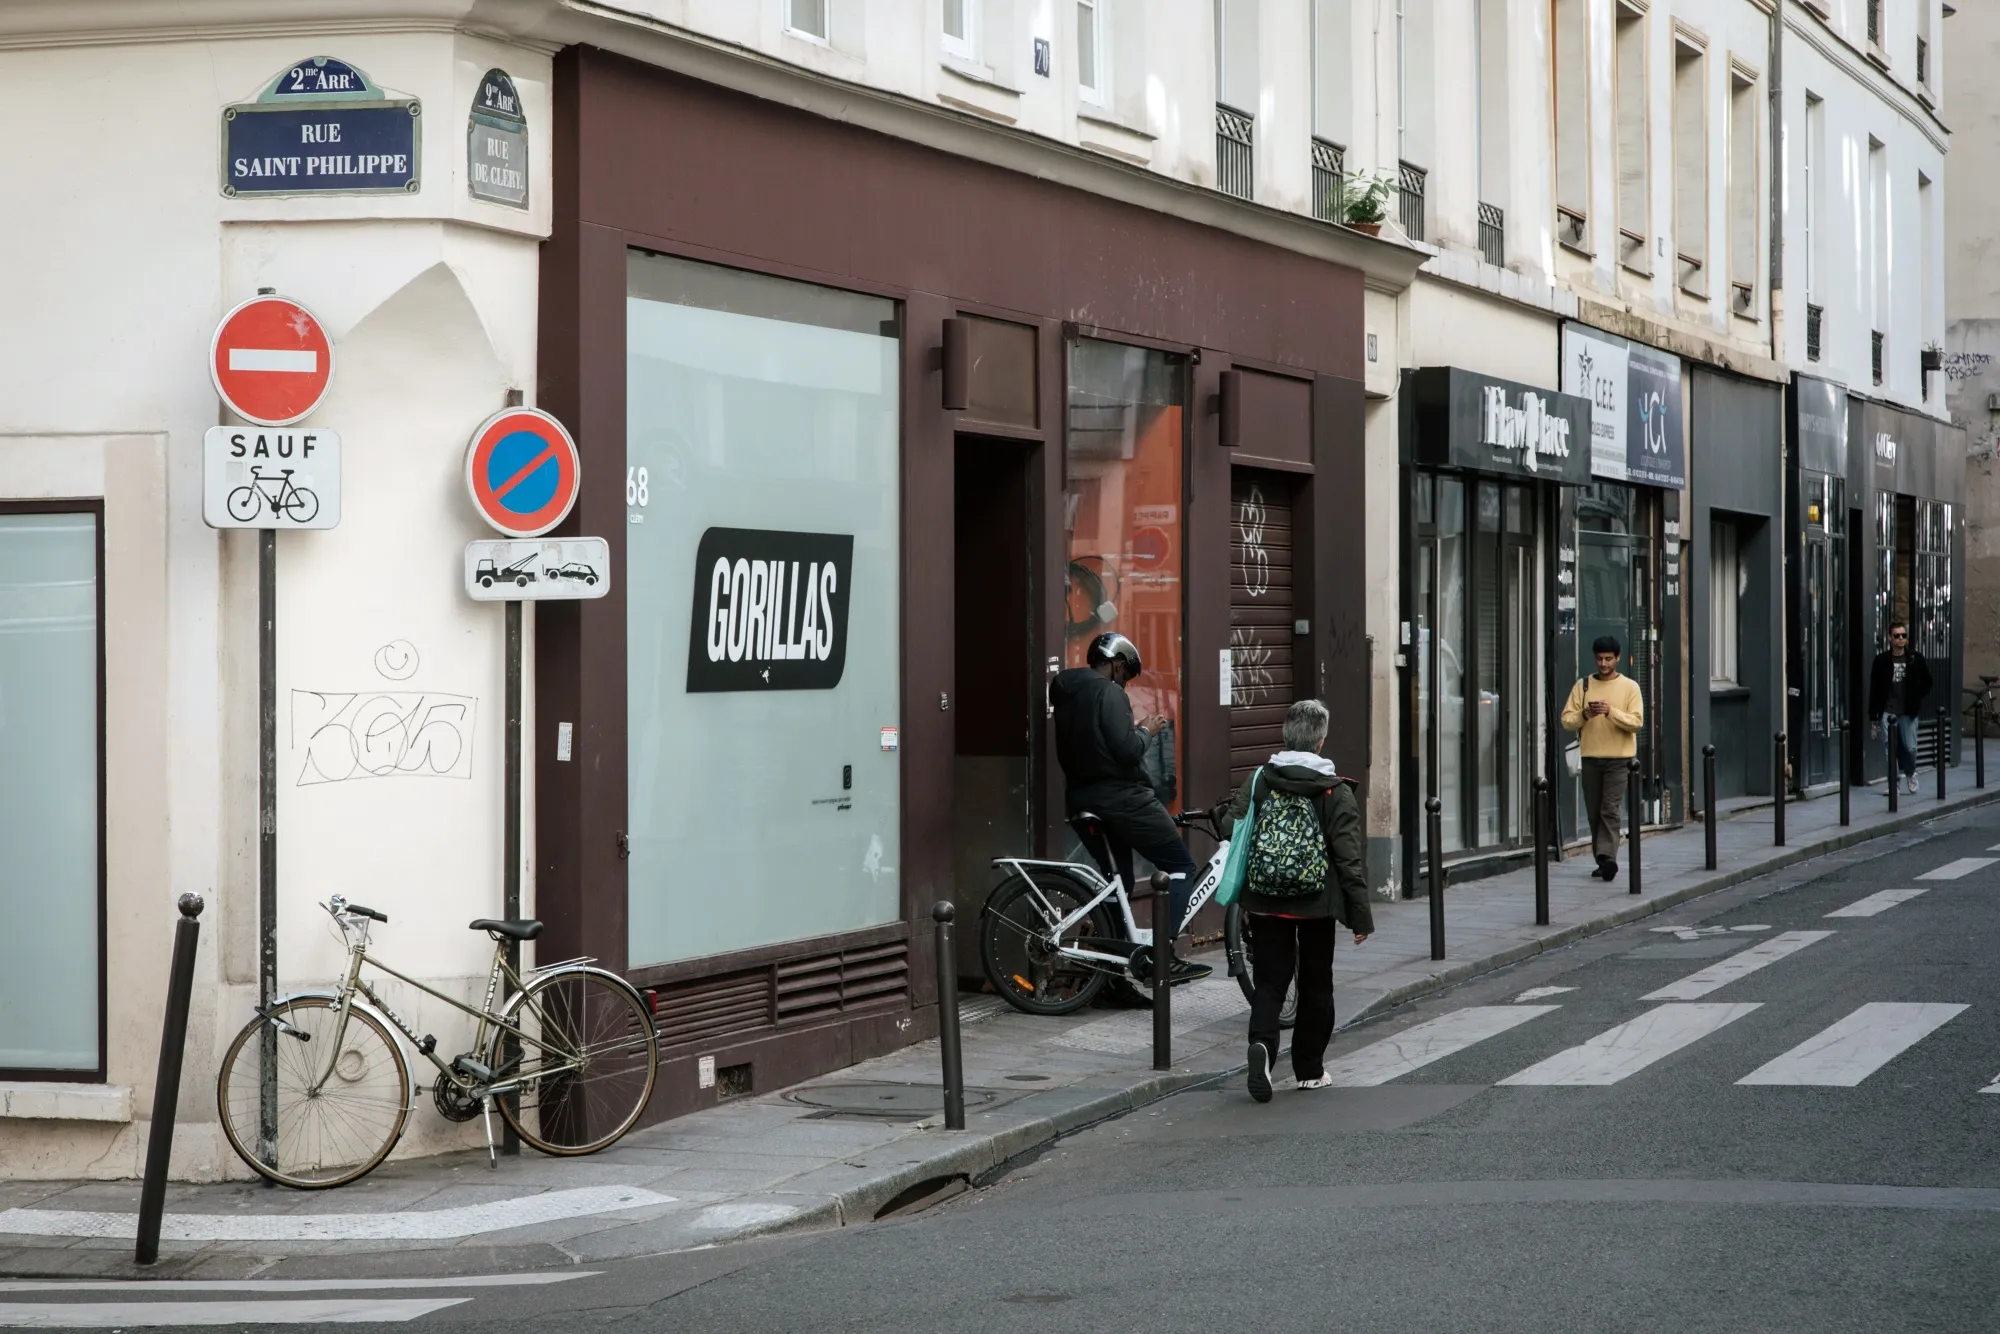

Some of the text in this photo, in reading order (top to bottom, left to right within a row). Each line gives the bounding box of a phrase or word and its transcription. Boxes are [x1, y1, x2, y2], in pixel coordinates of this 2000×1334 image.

[1036, 42, 1048, 72] 70
[301, 123, 341, 143] RUE
[487, 138, 509, 160] RUE
[234, 154, 407, 177] SAINT PHILIPPE
[475, 163, 489, 184] DE
[1596, 377, 1615, 412] C.E.E.
[230, 434, 317, 459] SAUF
[626, 466, 648, 507] 68
[708, 556, 837, 662] GORILLAS
[1183, 875, 1217, 917] oomo
